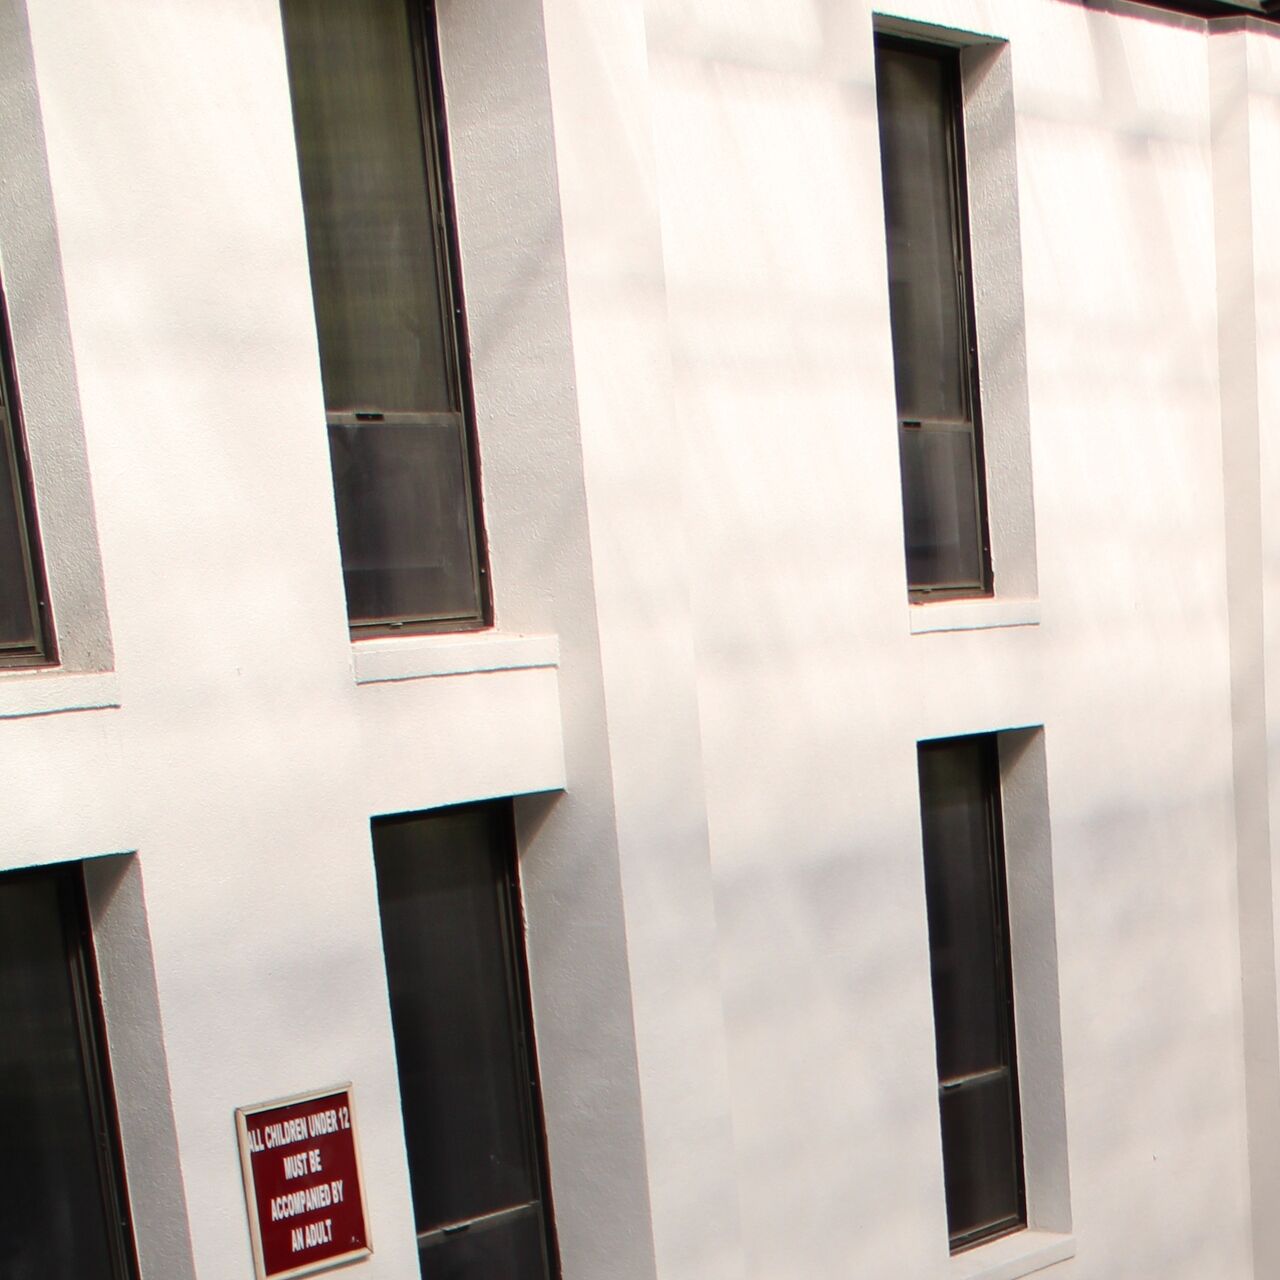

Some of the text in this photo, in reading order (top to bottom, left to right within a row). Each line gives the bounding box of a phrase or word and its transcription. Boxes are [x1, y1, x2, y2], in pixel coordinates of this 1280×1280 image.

[248, 1107, 350, 1152] ALL CHILDREN UNDER 12
[284, 1149, 322, 1180] MUST BE
[271, 1180, 344, 1221] ACCOMPANIED BY
[291, 1219, 332, 1252] AN ADULT
